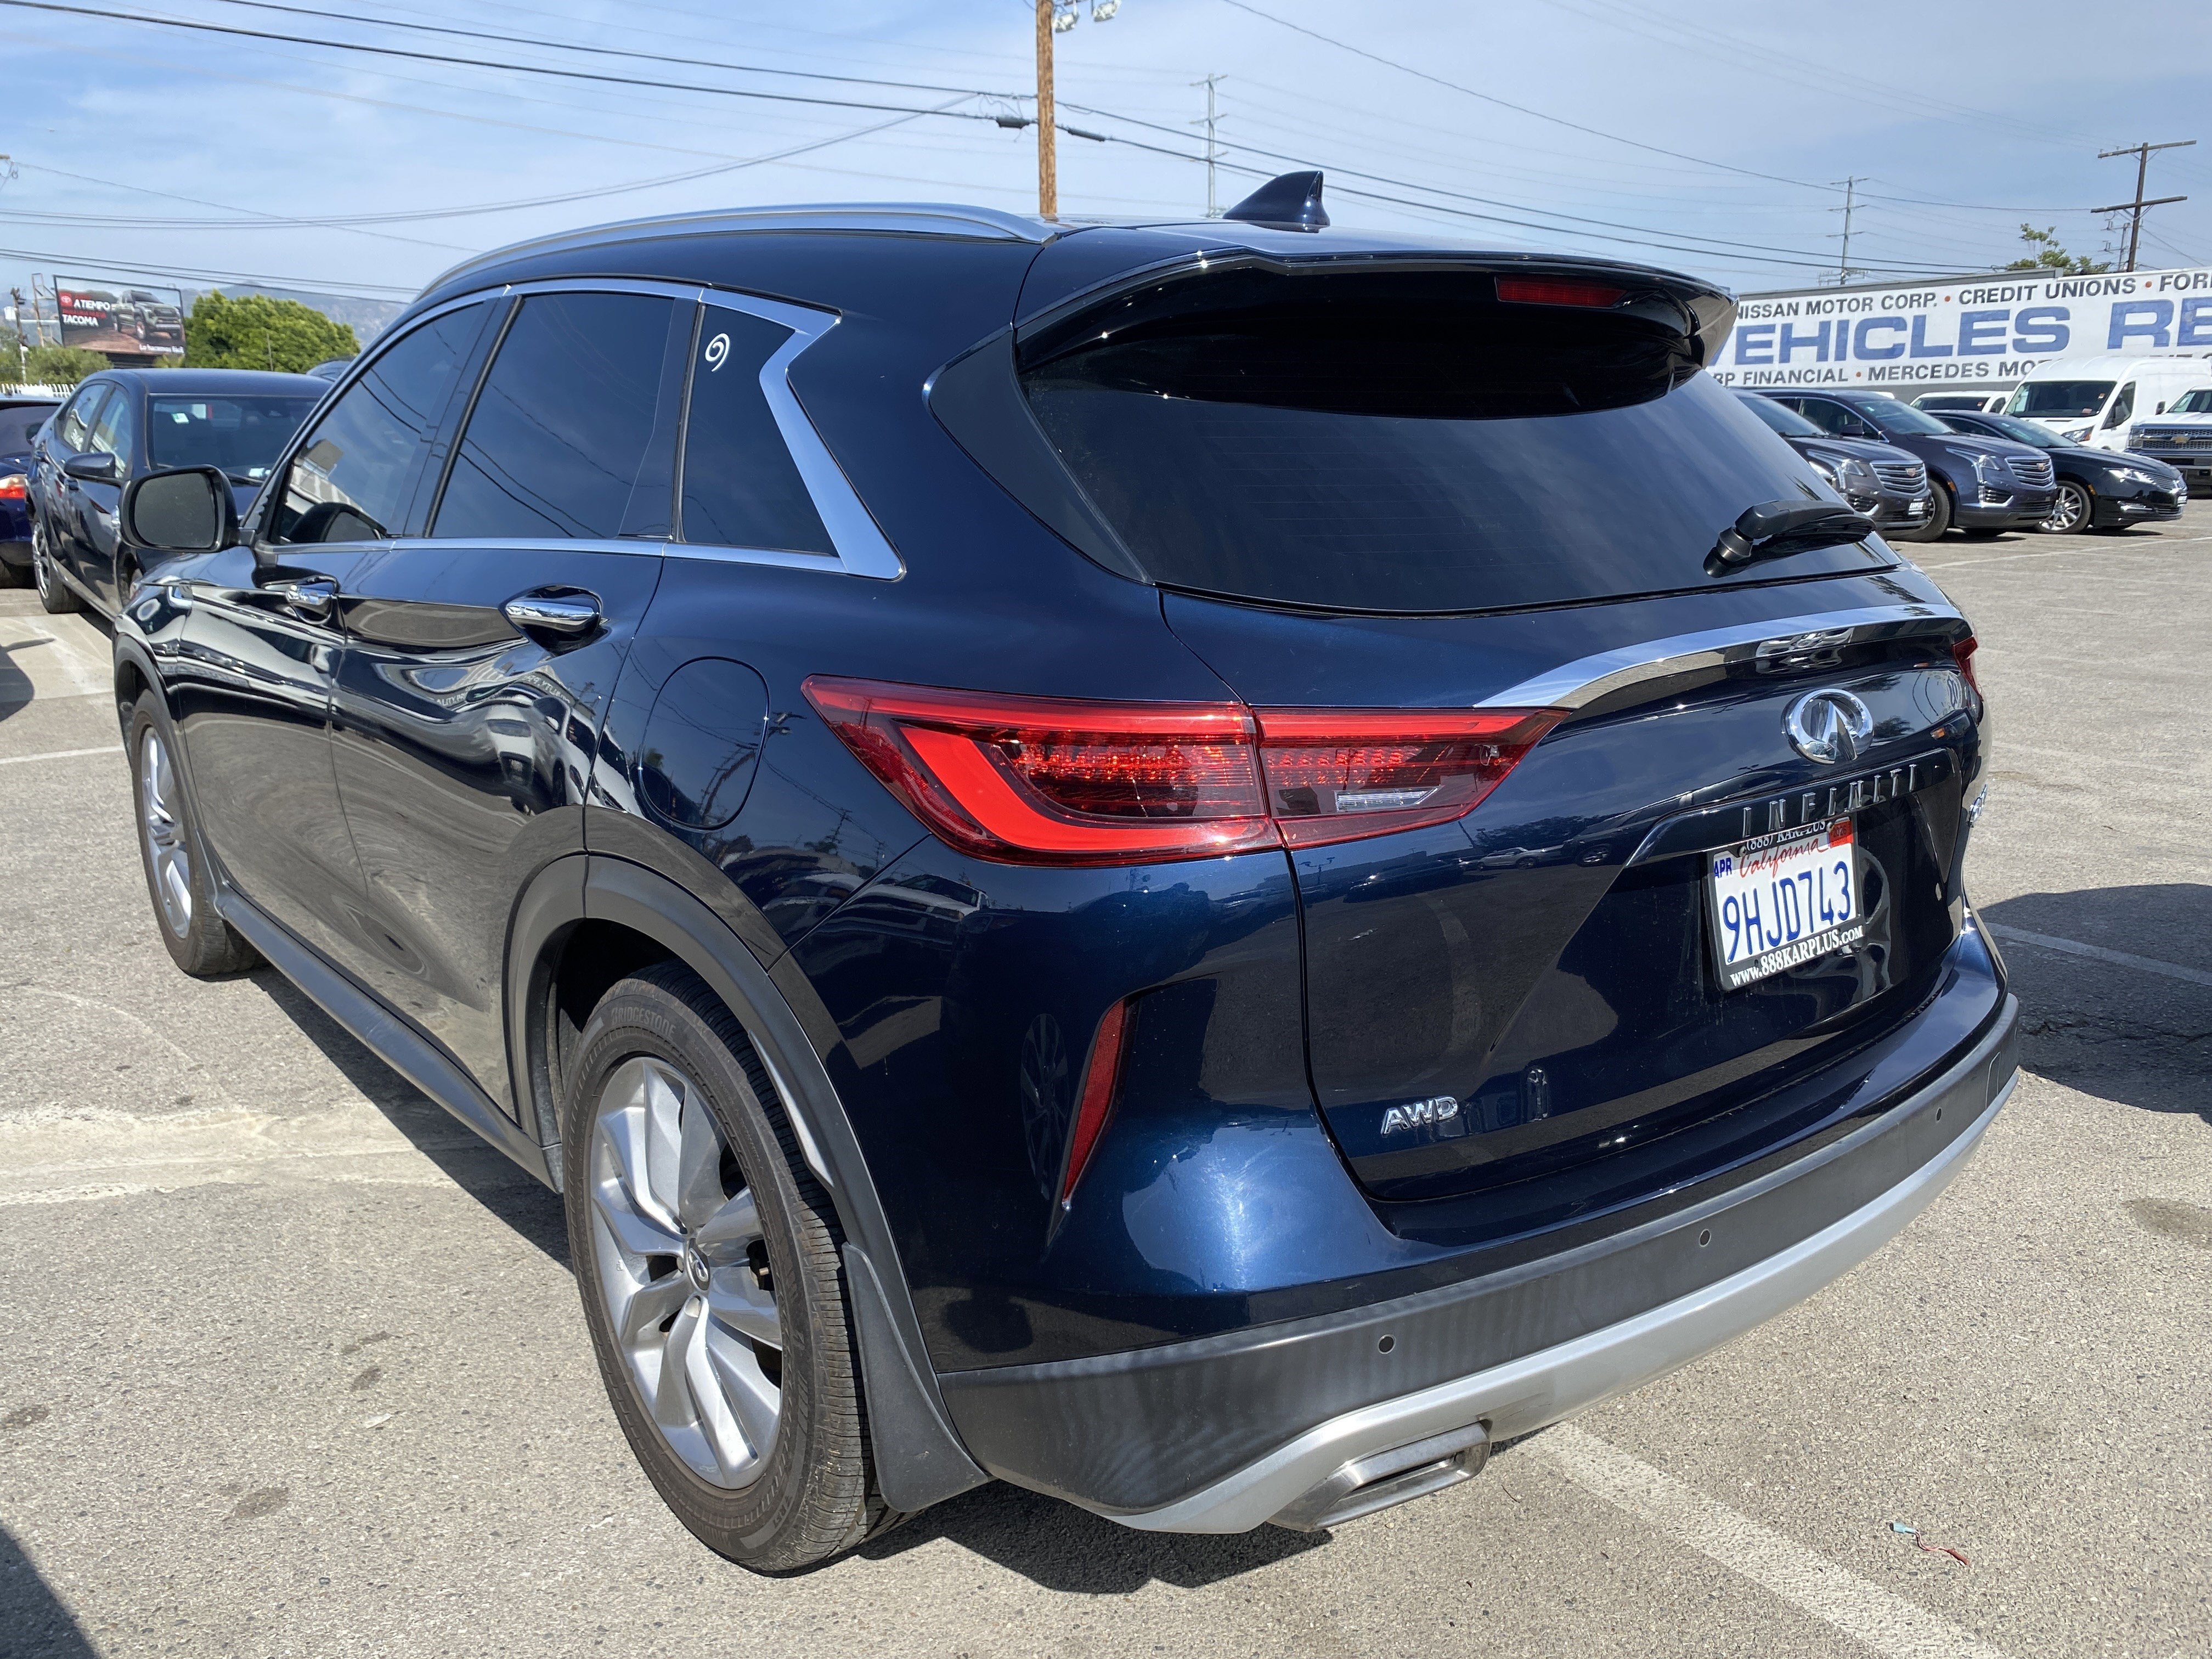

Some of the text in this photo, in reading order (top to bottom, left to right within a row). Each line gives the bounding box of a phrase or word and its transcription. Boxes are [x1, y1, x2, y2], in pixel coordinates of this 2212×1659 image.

[1737, 273, 2212, 319] NISSAN MOTOR CORP. CREDIT UNIONS FOR
[62, 314, 99, 327] TACOMA
[1707, 306, 2070, 366] EHICLES
[1712, 359, 2052, 385] RP FINANCIAL MERCEDES MO
[1743, 764, 1917, 838] INFINITI
[1714, 857, 1732, 878] APR
[1740, 838, 1829, 878] California
[1723, 861, 1850, 962] 9HJD743
[611, 1006, 677, 1041] BRIDGESTONE
[1380, 1096, 1458, 1137] AWD
